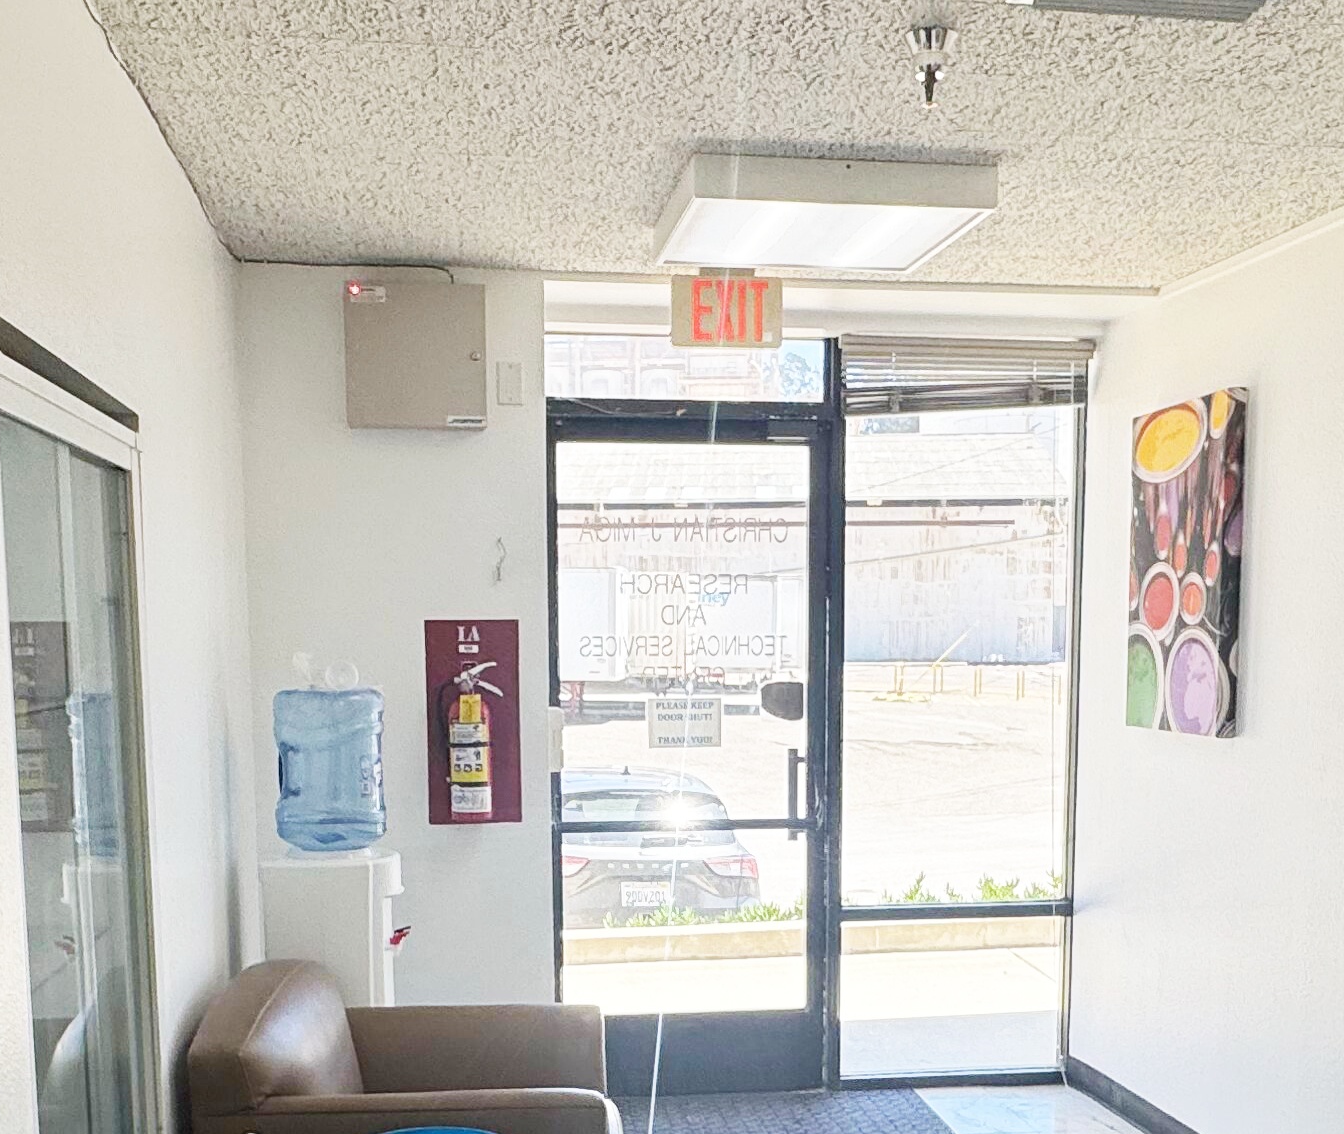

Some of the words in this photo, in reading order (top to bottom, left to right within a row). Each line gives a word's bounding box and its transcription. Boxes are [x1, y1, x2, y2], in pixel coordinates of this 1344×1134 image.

[692, 279, 768, 342] EXIT
[656, 701, 688, 710] PLEASE
[690, 701, 714, 710] KEEP
[657, 713, 684, 721] DOOR
